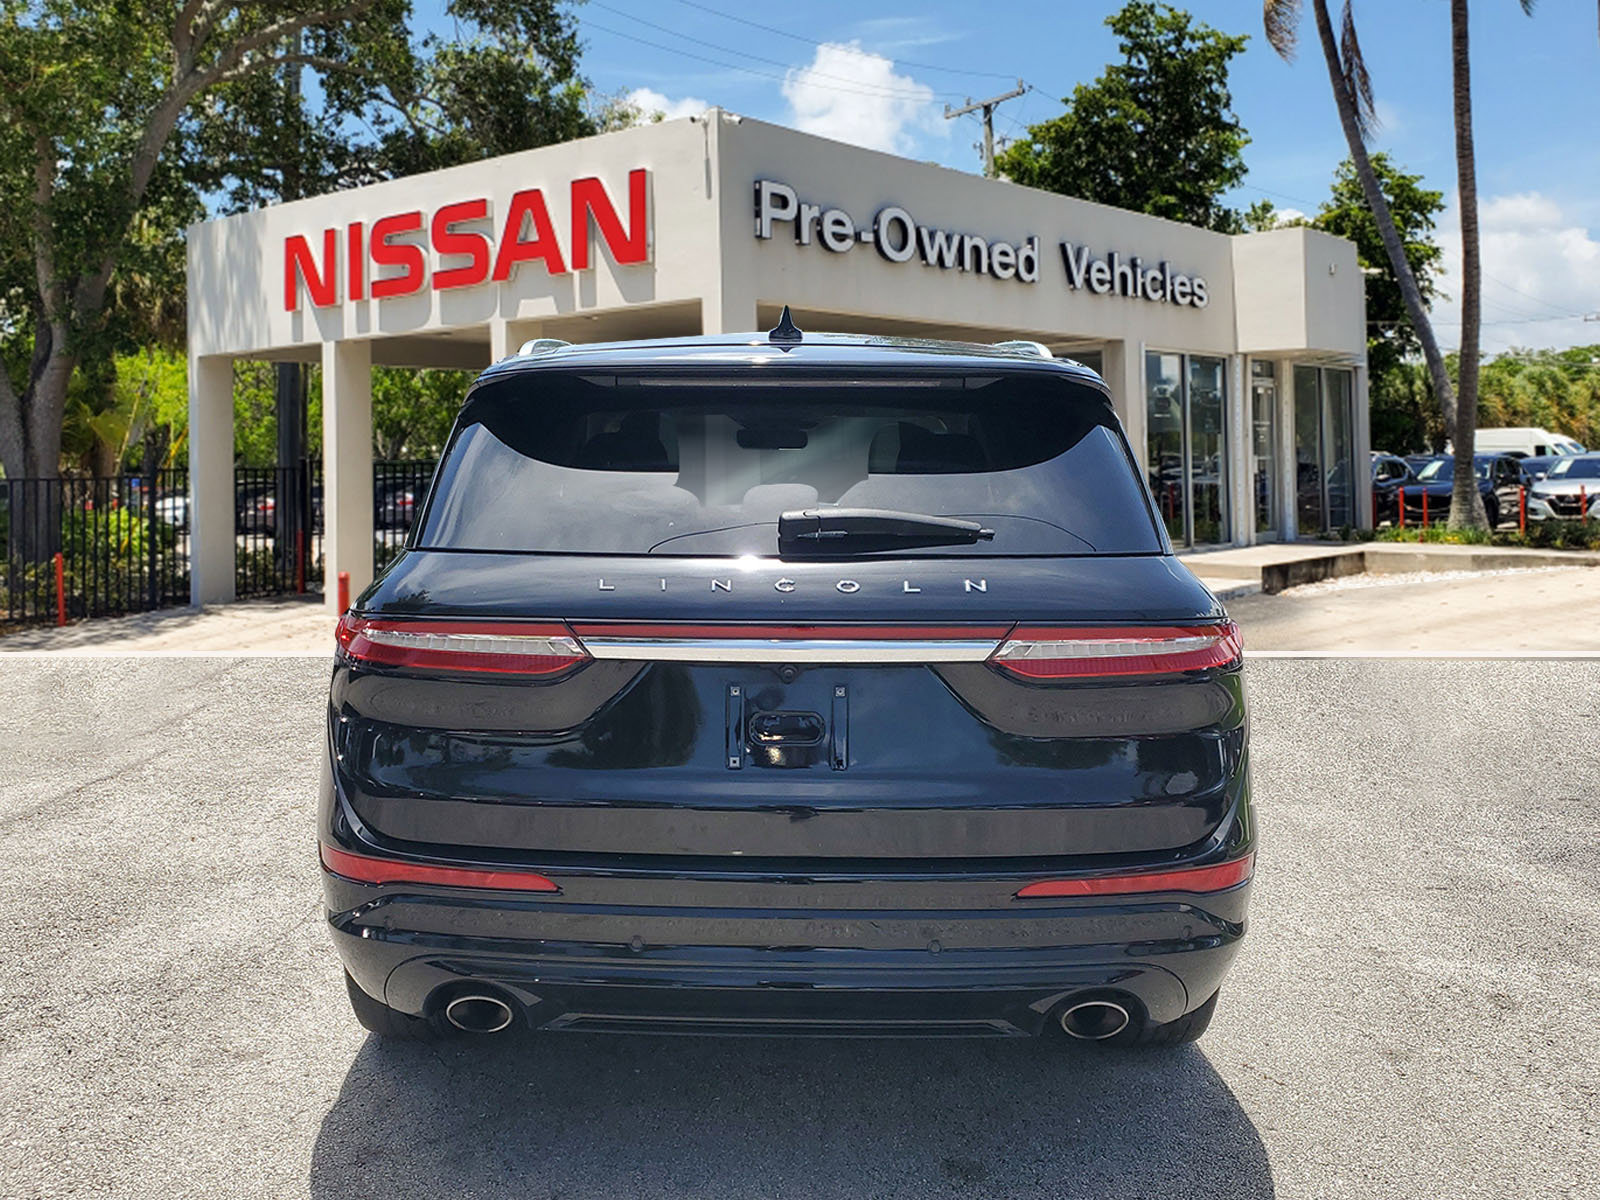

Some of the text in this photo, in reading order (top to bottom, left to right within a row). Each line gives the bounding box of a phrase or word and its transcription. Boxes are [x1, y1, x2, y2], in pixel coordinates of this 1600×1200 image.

[285, 168, 649, 312] NISSAN
[754, 179, 1209, 309] Pre-Owned Vehicles
[599, 578, 988, 593] LINCOLN
